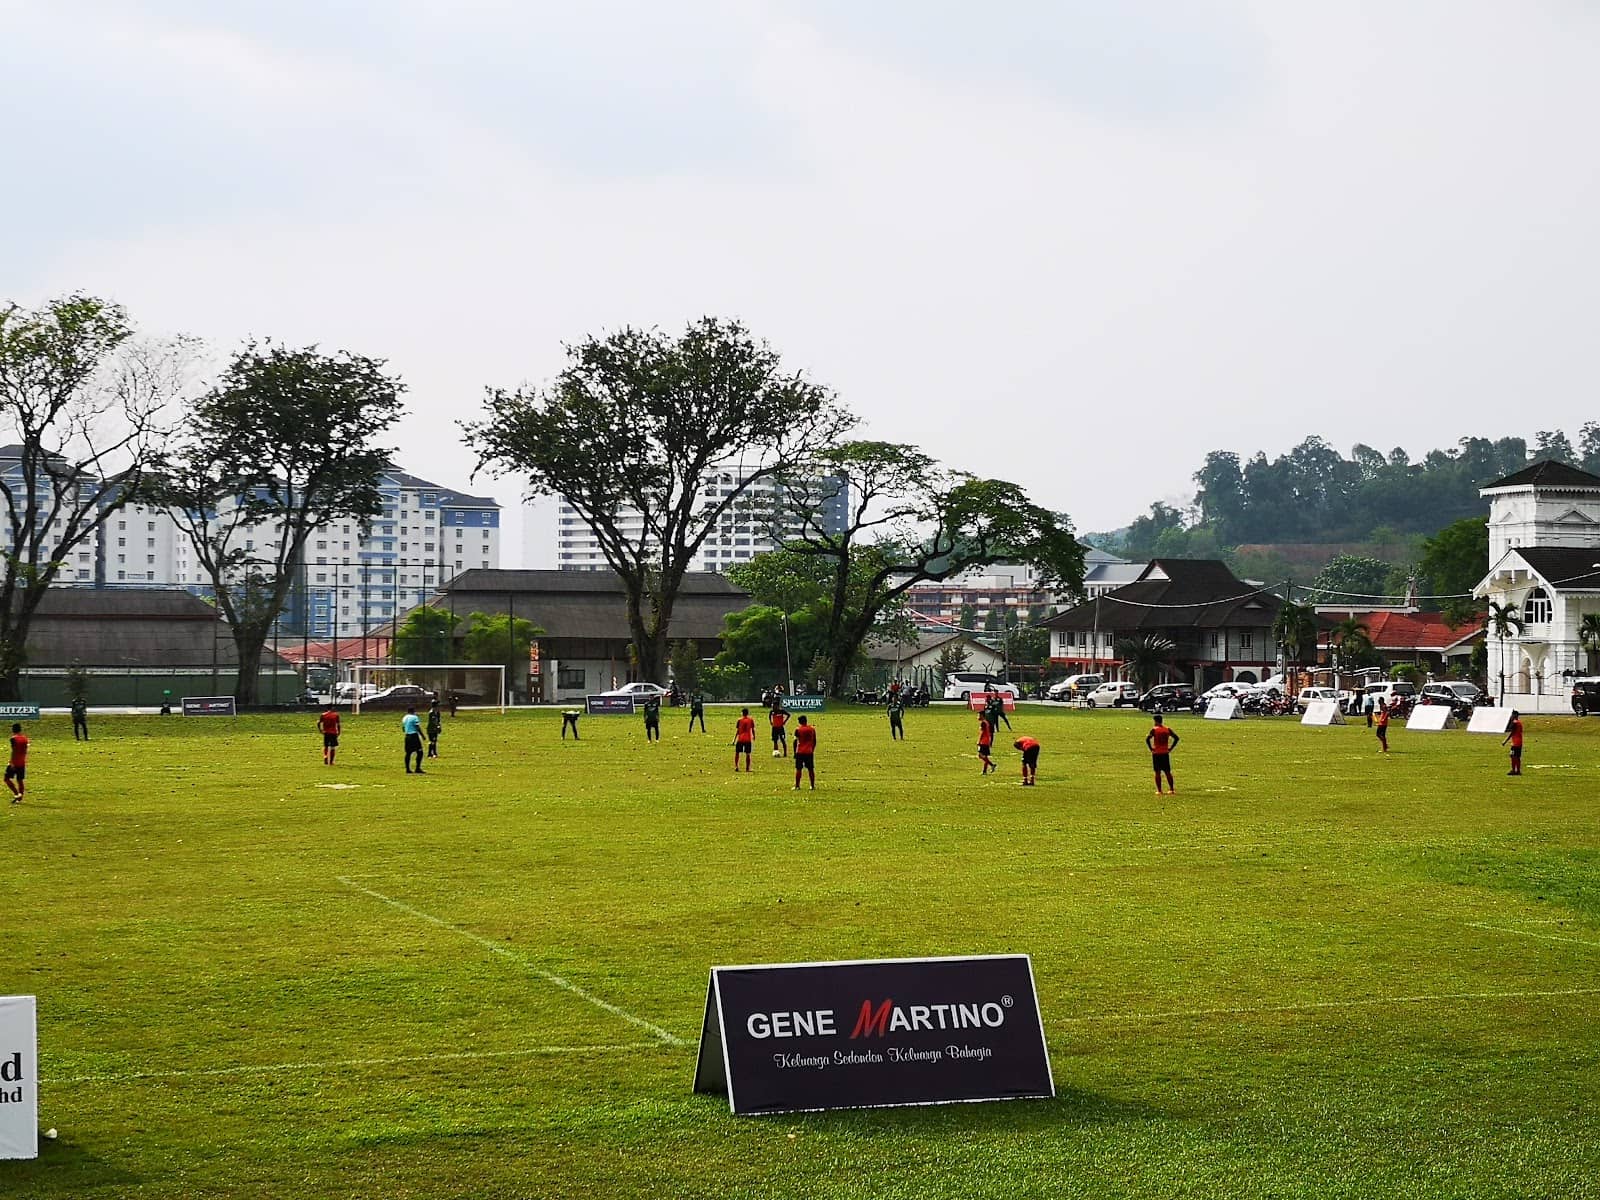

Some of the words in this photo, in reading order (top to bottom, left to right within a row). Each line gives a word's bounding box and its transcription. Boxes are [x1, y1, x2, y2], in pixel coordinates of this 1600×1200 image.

[782, 699, 823, 707] SPRITZER
[747, 1009, 837, 1039] GENE
[773, 1052, 830, 1070] Keluarga
[833, 1050, 884, 1066] Sedondon
[887, 1047, 943, 1064] Keluarga
[945, 1044, 993, 1062] Bahagia
